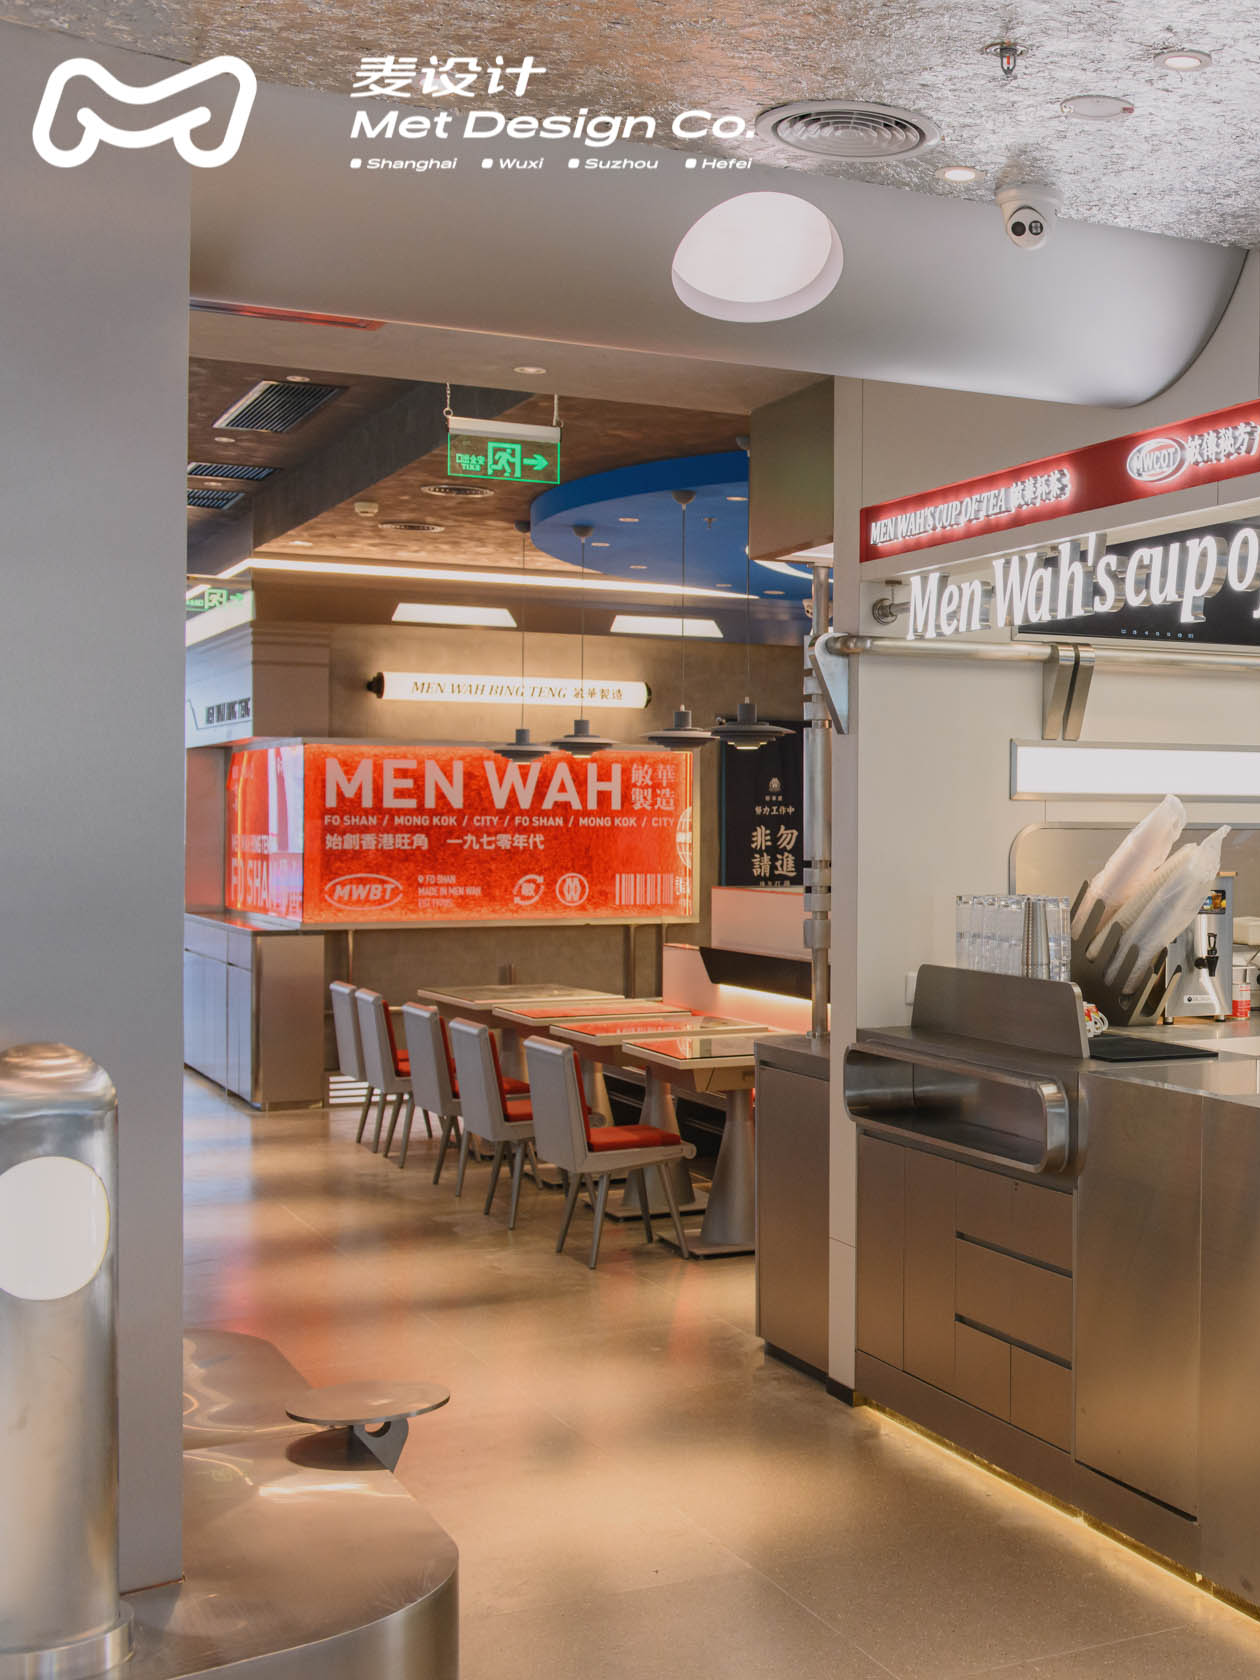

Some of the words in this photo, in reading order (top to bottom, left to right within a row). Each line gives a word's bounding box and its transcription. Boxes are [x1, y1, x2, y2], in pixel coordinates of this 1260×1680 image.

[871, 517, 897, 544] MEN
[898, 506, 934, 537] WAH'S
[935, 501, 960, 529] CUP
[962, 494, 978, 523] OF
[980, 487, 1006, 518] TEA
[907, 570, 984, 640] Men
[993, 532, 1117, 628] Wah's
[1125, 536, 1220, 624] cup
[412, 681, 446, 695] MEN
[451, 681, 486, 696] WAH
[489, 683, 525, 697] BING
[529, 686, 567, 699] TENG
[325, 757, 464, 809] MEN
[483, 760, 622, 811] WAH
[631, 763, 676, 788] 敏華
[631, 787, 676, 811] 製造
[324, 815, 340, 826] FO
[343, 815, 377, 826] SHAN
[394, 815, 429, 827] MONG
[432, 815, 457, 827] KOK
[473, 815, 499, 827] CITY
[514, 815, 529, 827] FO
[532, 815, 564, 827] SHAN
[579, 815, 612, 828] MONG
[614, 815, 637, 828] KOK
[651, 815, 675, 828] CITY
[325, 833, 429, 850] 始創香港旺角
[446, 834, 545, 850] 一九七零年代
[333, 884, 395, 901] MWBT
